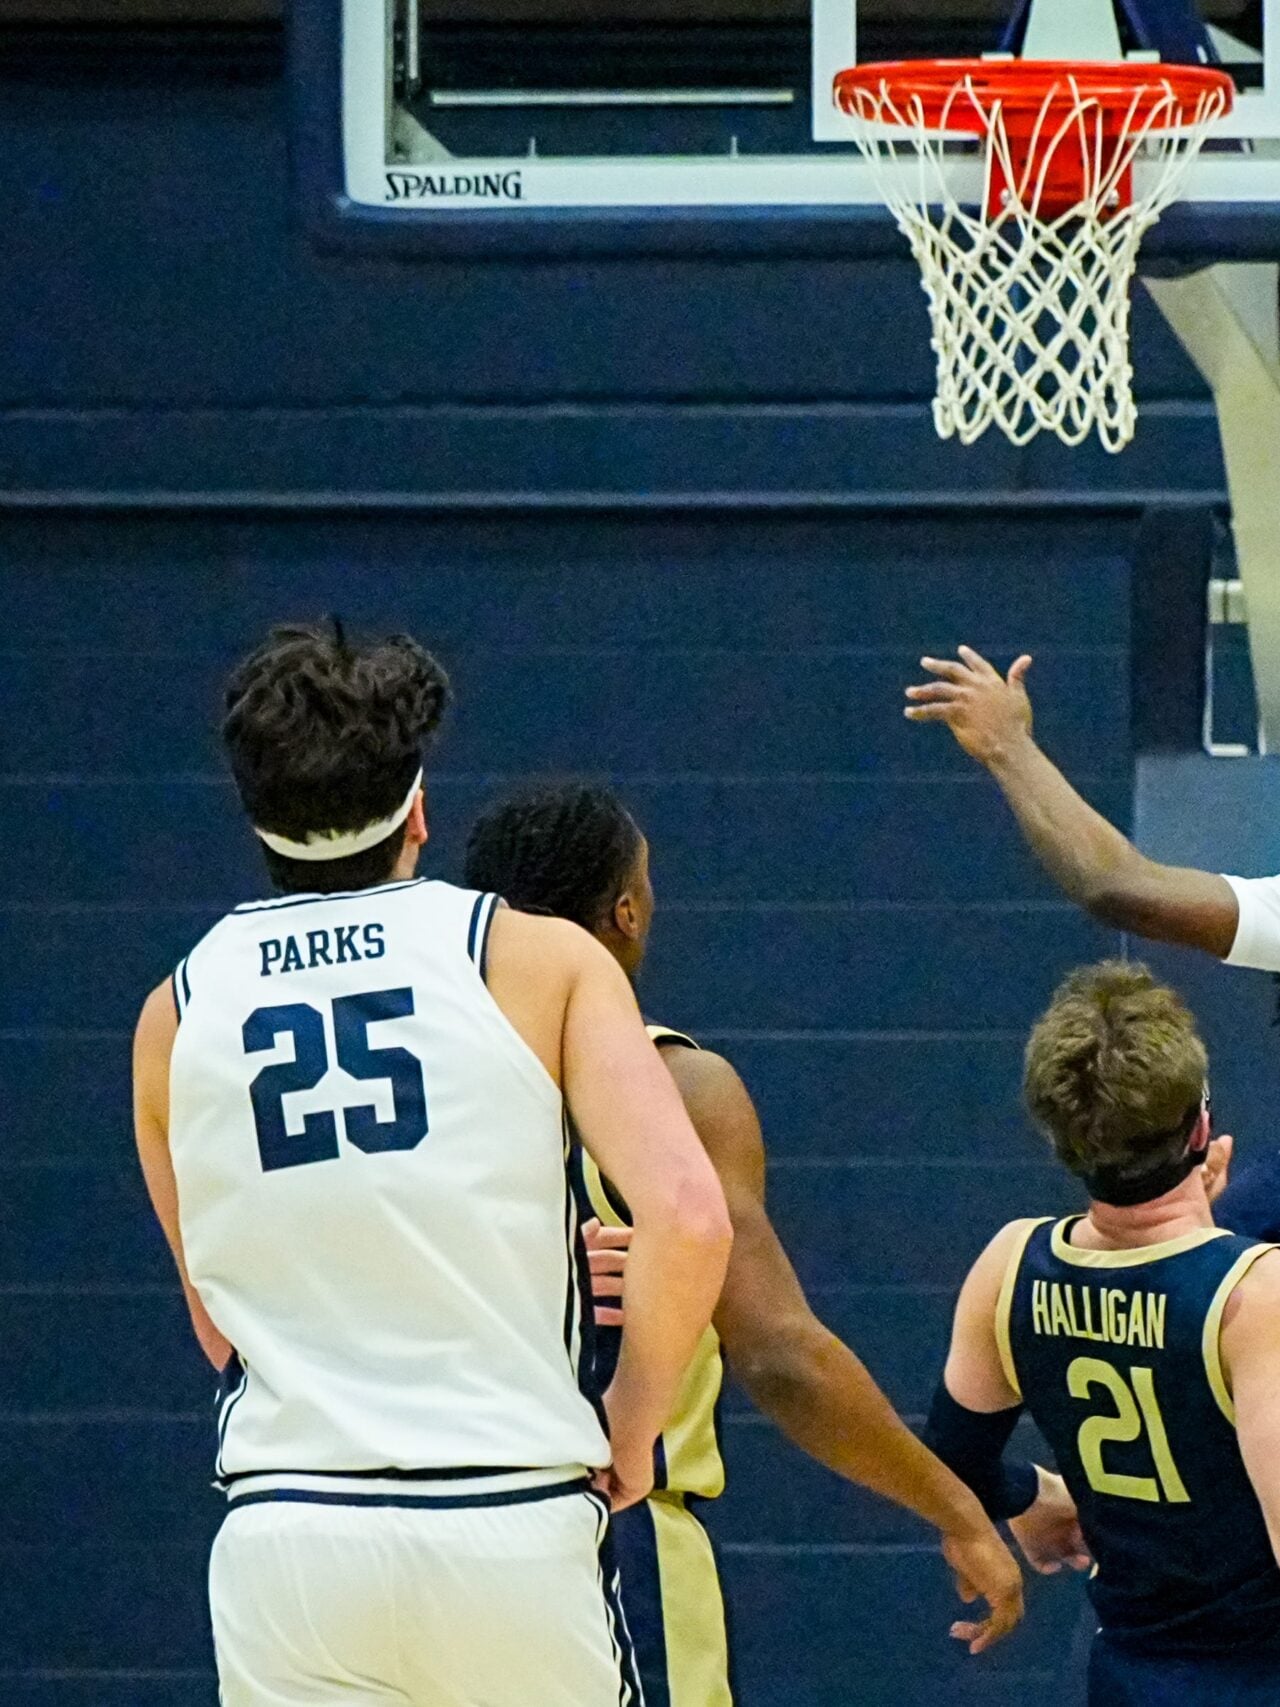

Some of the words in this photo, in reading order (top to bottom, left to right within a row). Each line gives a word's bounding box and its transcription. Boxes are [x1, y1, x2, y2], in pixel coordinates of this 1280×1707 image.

[385, 170, 522, 201] SPALDING
[258, 923, 386, 977] PARKS
[241, 986, 429, 1173] 25
[1031, 1279, 1167, 1350] HALLIGAN
[1066, 1356, 1192, 1504] 21
